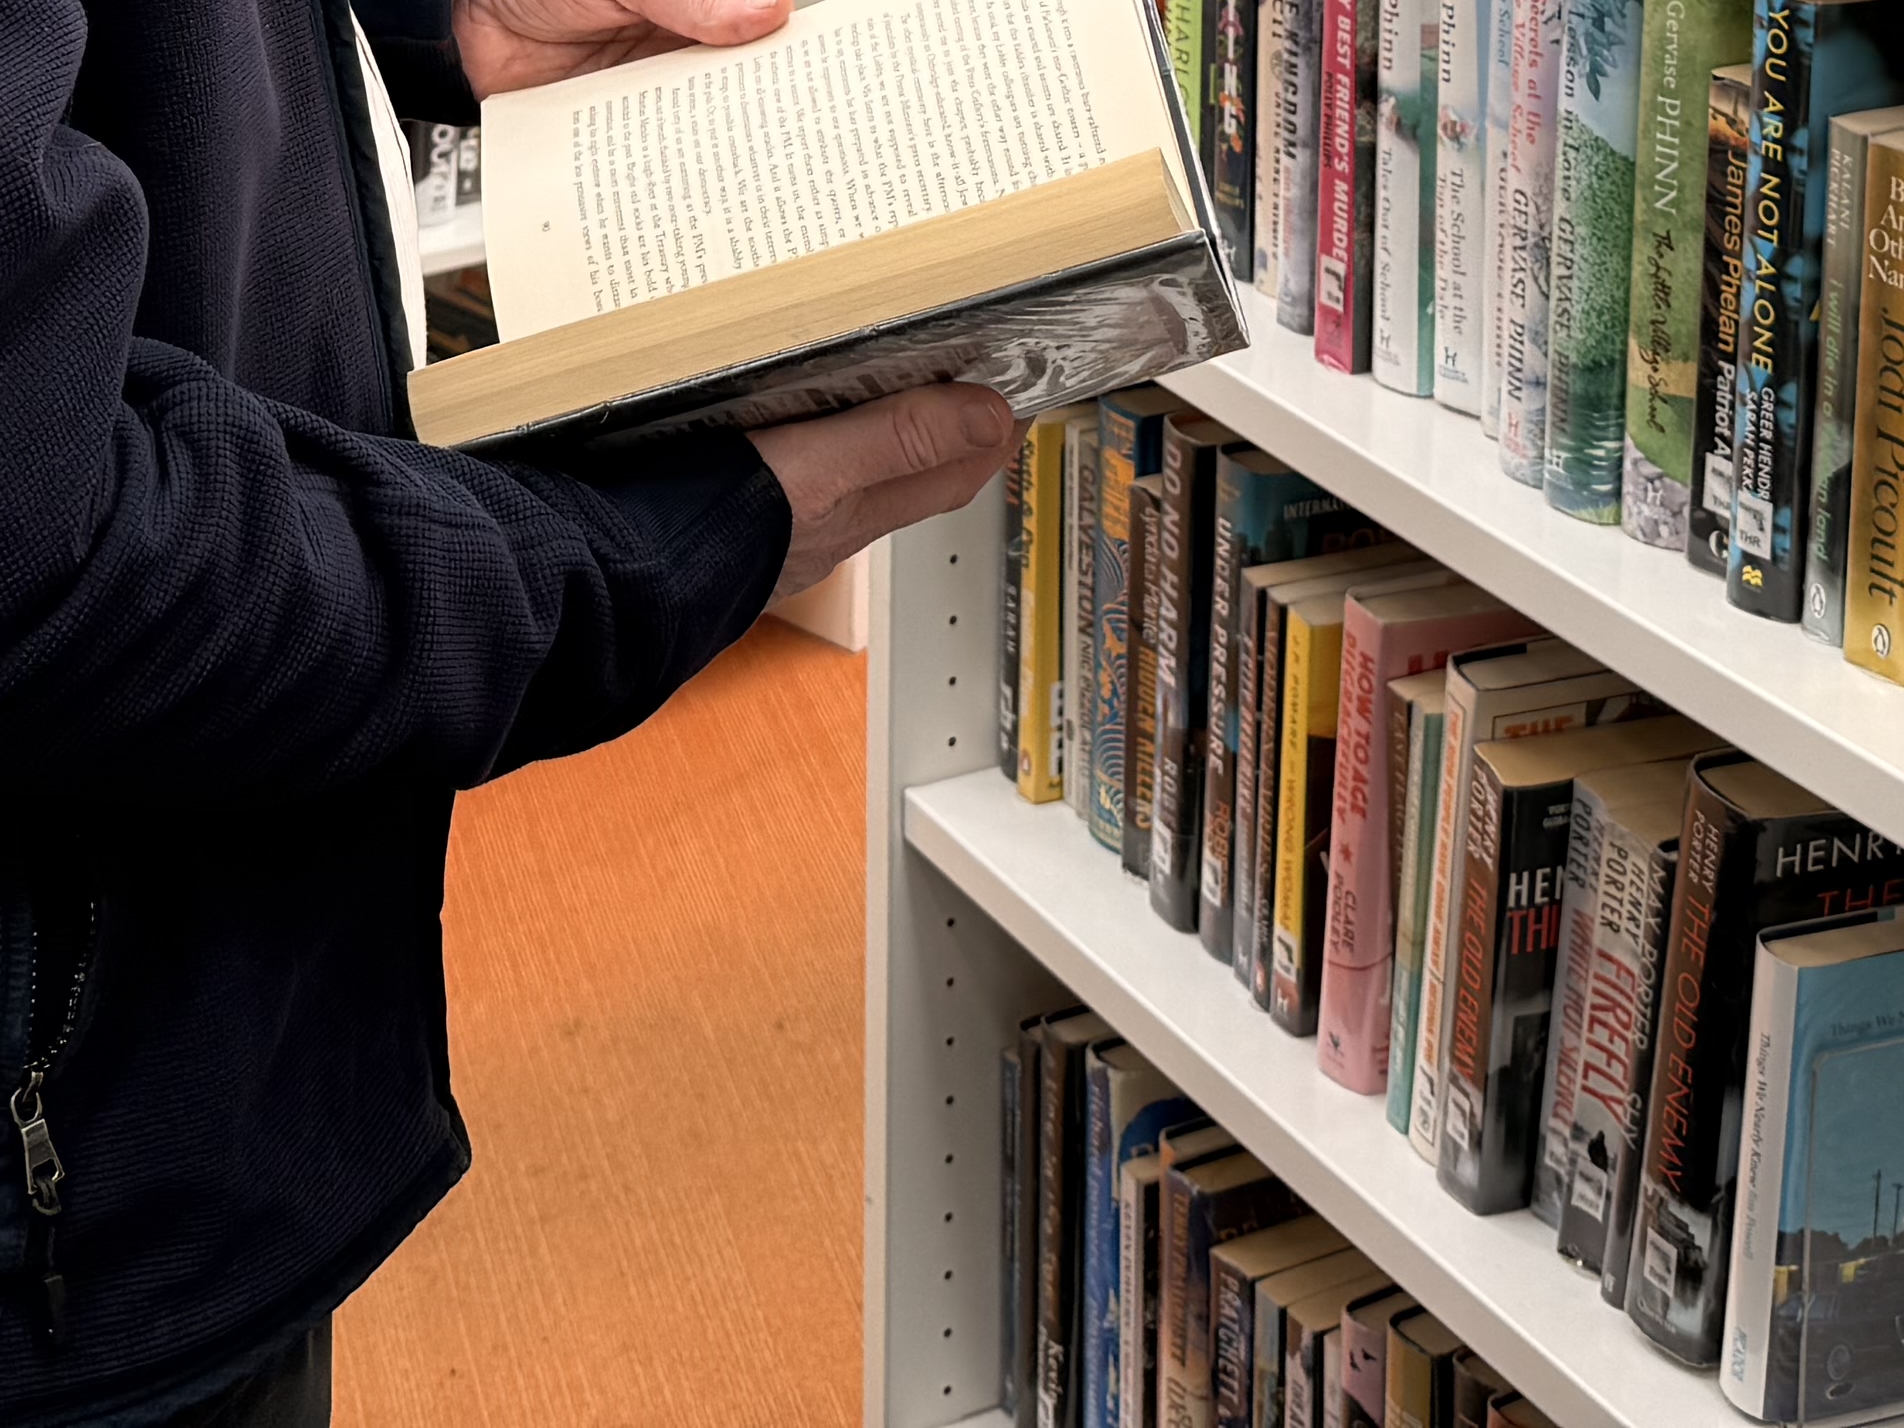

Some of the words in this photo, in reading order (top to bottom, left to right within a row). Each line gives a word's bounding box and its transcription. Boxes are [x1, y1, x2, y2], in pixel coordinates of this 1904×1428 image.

[1333, 17, 1353, 70] BEST
[1763, 6, 1790, 75] YOU
[1331, 73, 1353, 173] FRIEND'S
[1759, 89, 1787, 160] ARE
[1329, 179, 1352, 266] MURDE
[1756, 174, 1782, 251] NOT
[1750, 260, 1777, 375] ALONE
[1684, 902, 1713, 966] THE
[1580, 947, 1637, 1127] FIREFLY
[1675, 971, 1699, 1058] OLD
[1656, 1060, 1694, 1192] ENEMY
